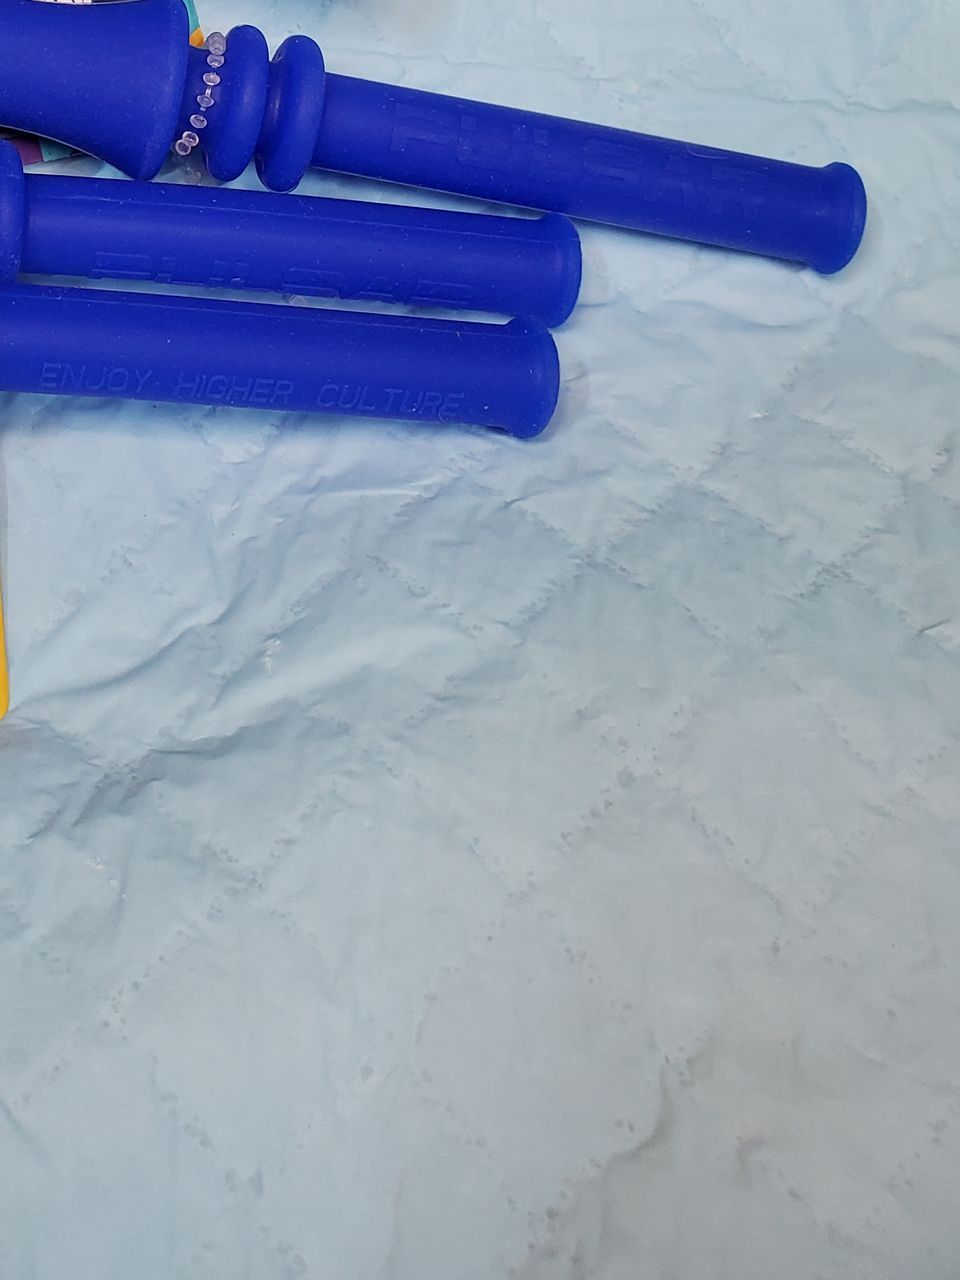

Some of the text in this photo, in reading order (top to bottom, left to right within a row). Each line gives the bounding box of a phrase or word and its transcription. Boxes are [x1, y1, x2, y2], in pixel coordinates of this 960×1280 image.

[37, 361, 465, 421] ENJOY HIGHER CULTURE
